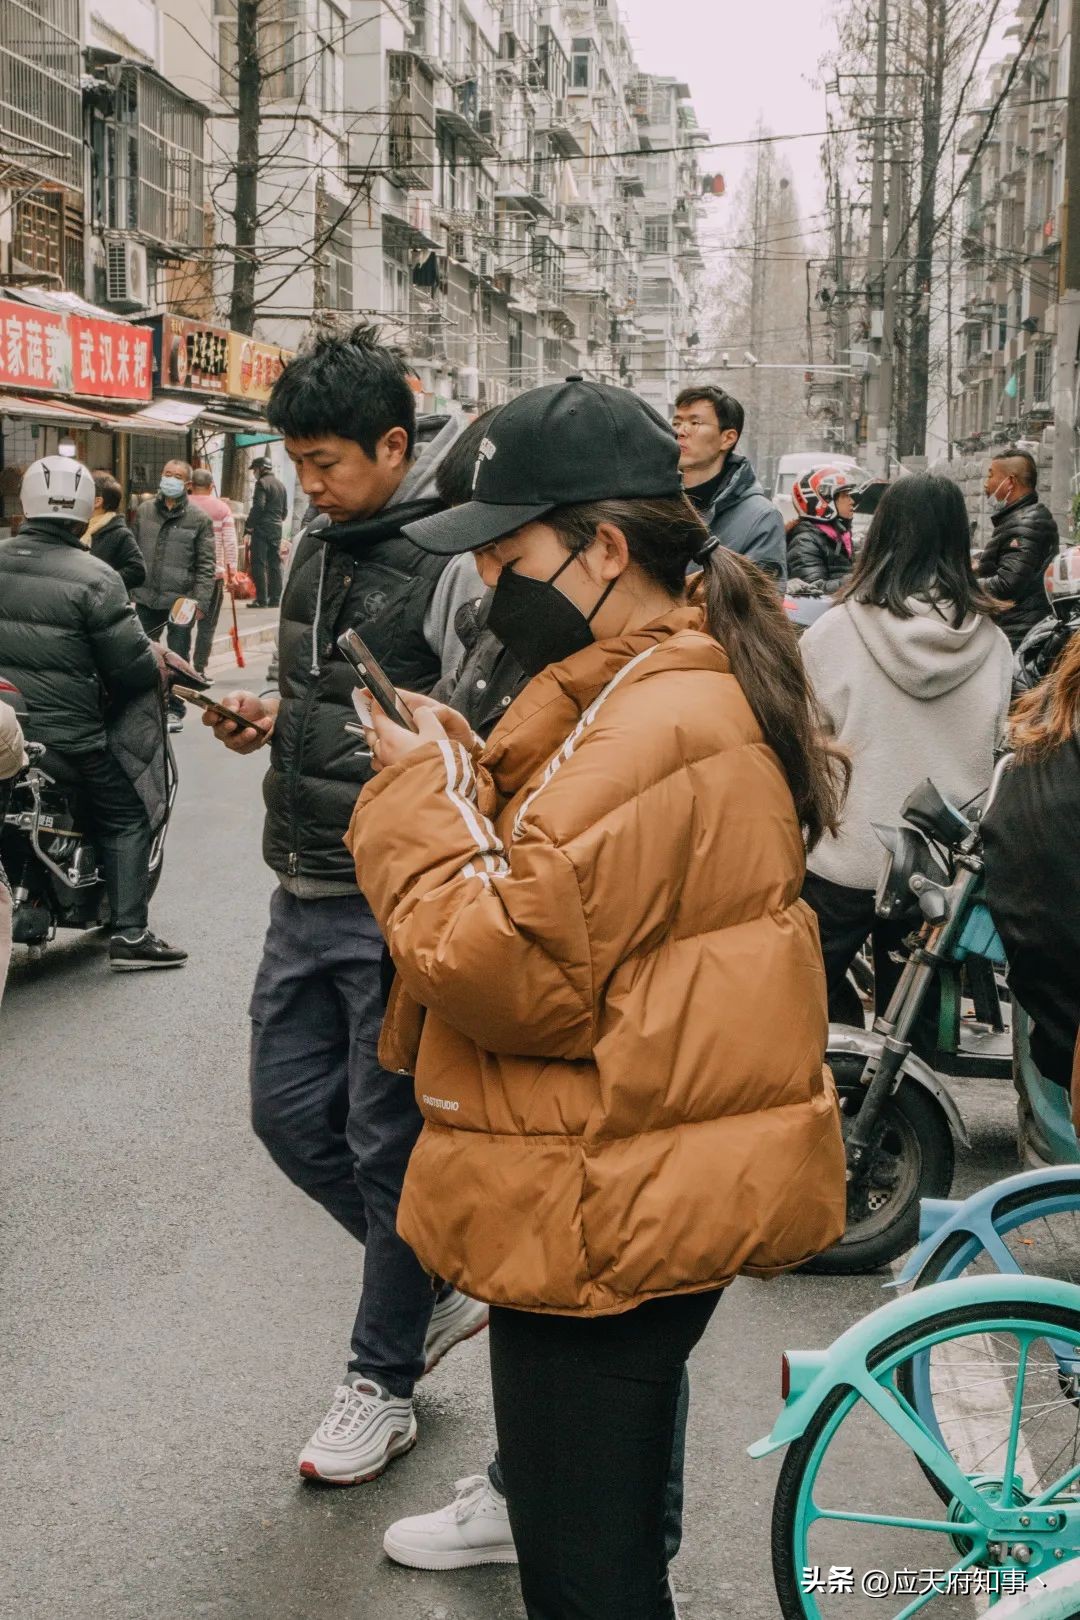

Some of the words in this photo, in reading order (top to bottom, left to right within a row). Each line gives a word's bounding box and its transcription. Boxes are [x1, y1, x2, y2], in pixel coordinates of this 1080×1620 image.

[0, 314, 66, 384] 家蔬菜
[79, 327, 148, 388] 武汉米粑
